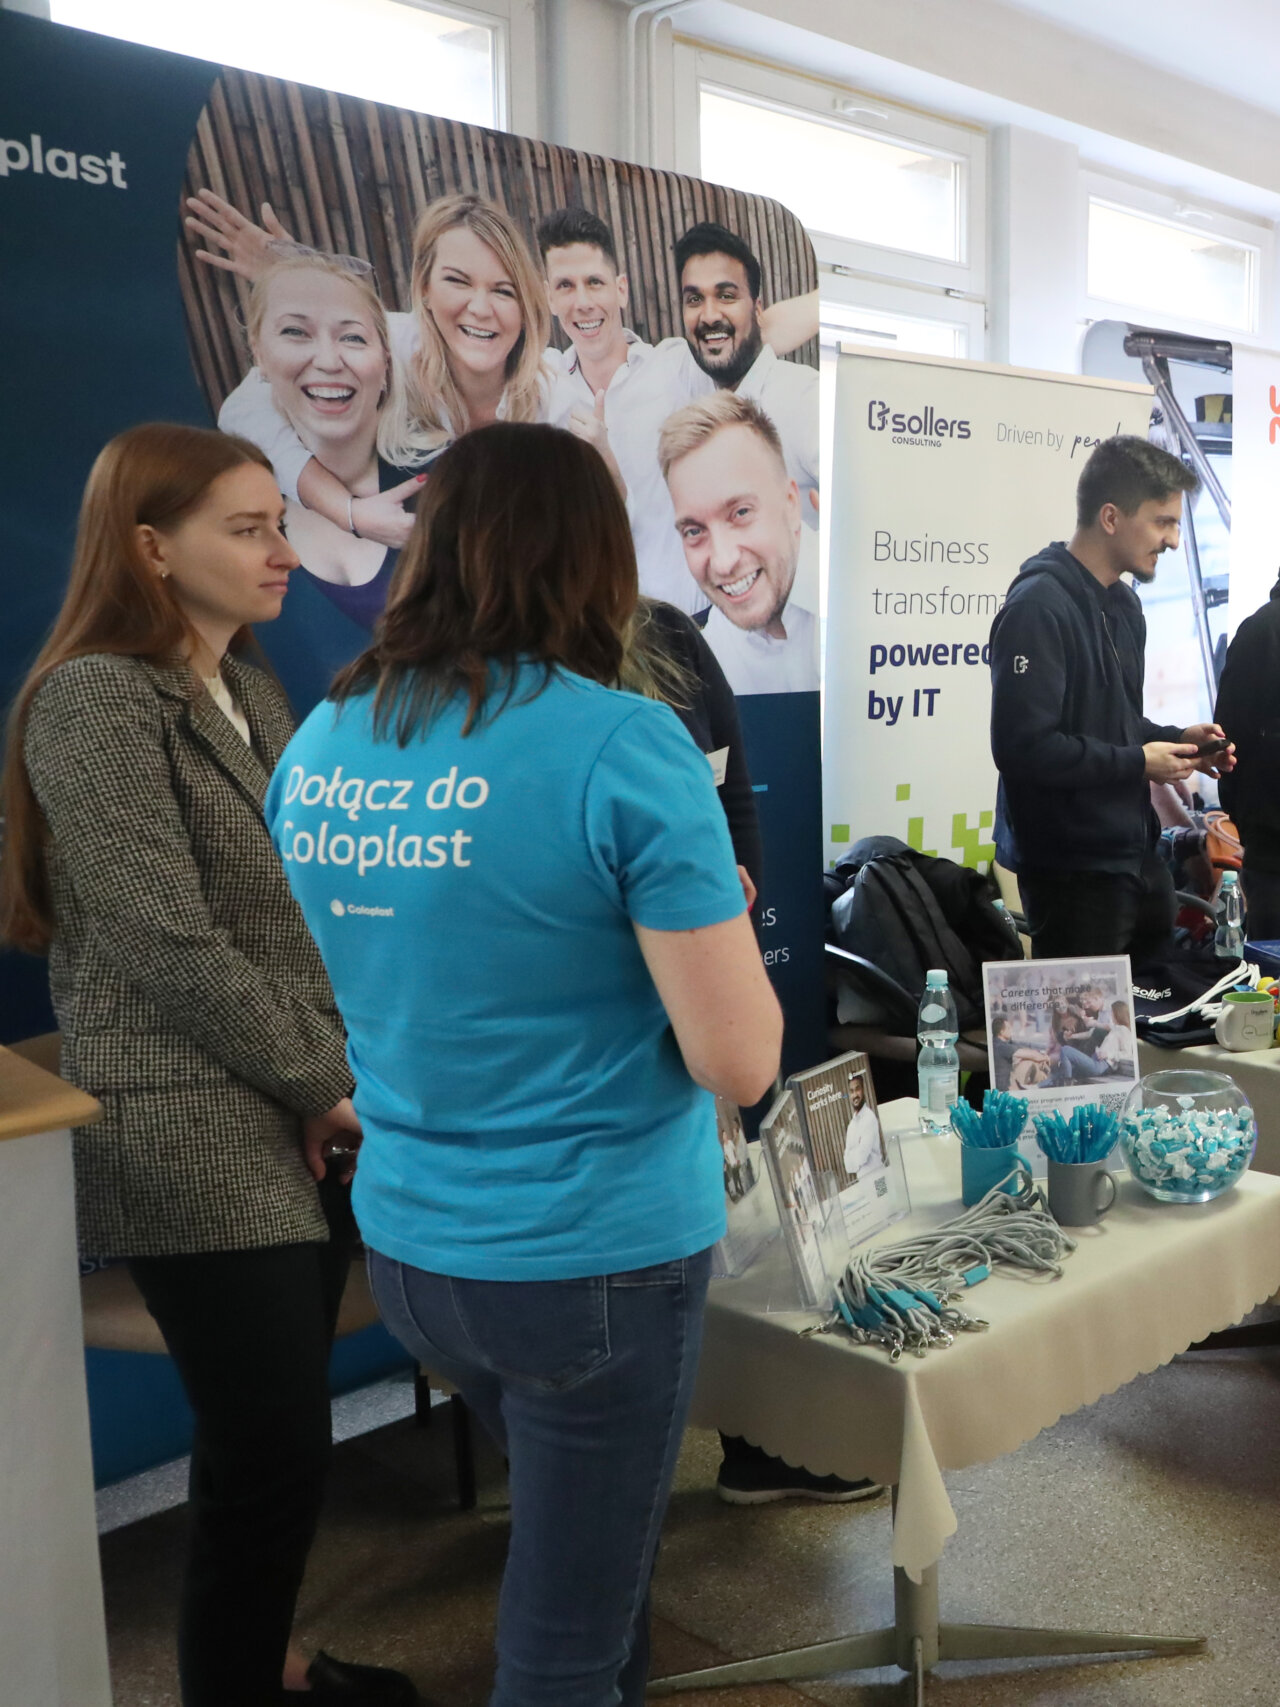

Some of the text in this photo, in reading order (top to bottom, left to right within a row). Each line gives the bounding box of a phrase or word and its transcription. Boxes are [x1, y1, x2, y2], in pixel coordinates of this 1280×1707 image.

[0, 133, 128, 190] plast
[891, 405, 972, 440] sollers
[997, 422, 1043, 446] Driven
[1046, 428, 1064, 451] by
[891, 436, 942, 448] CONSULTING
[874, 530, 989, 565] Business
[868, 688, 941, 726] by IT
[284, 765, 490, 821] Dołącz do
[282, 820, 473, 877] Coloplast
[347, 904, 395, 917] Coloplast
[1001, 983, 1092, 998] Careers that make
[1010, 1001, 1060, 1012] difference
[807, 1083, 833, 1101] Curiosity
[809, 1098, 828, 1112] works
